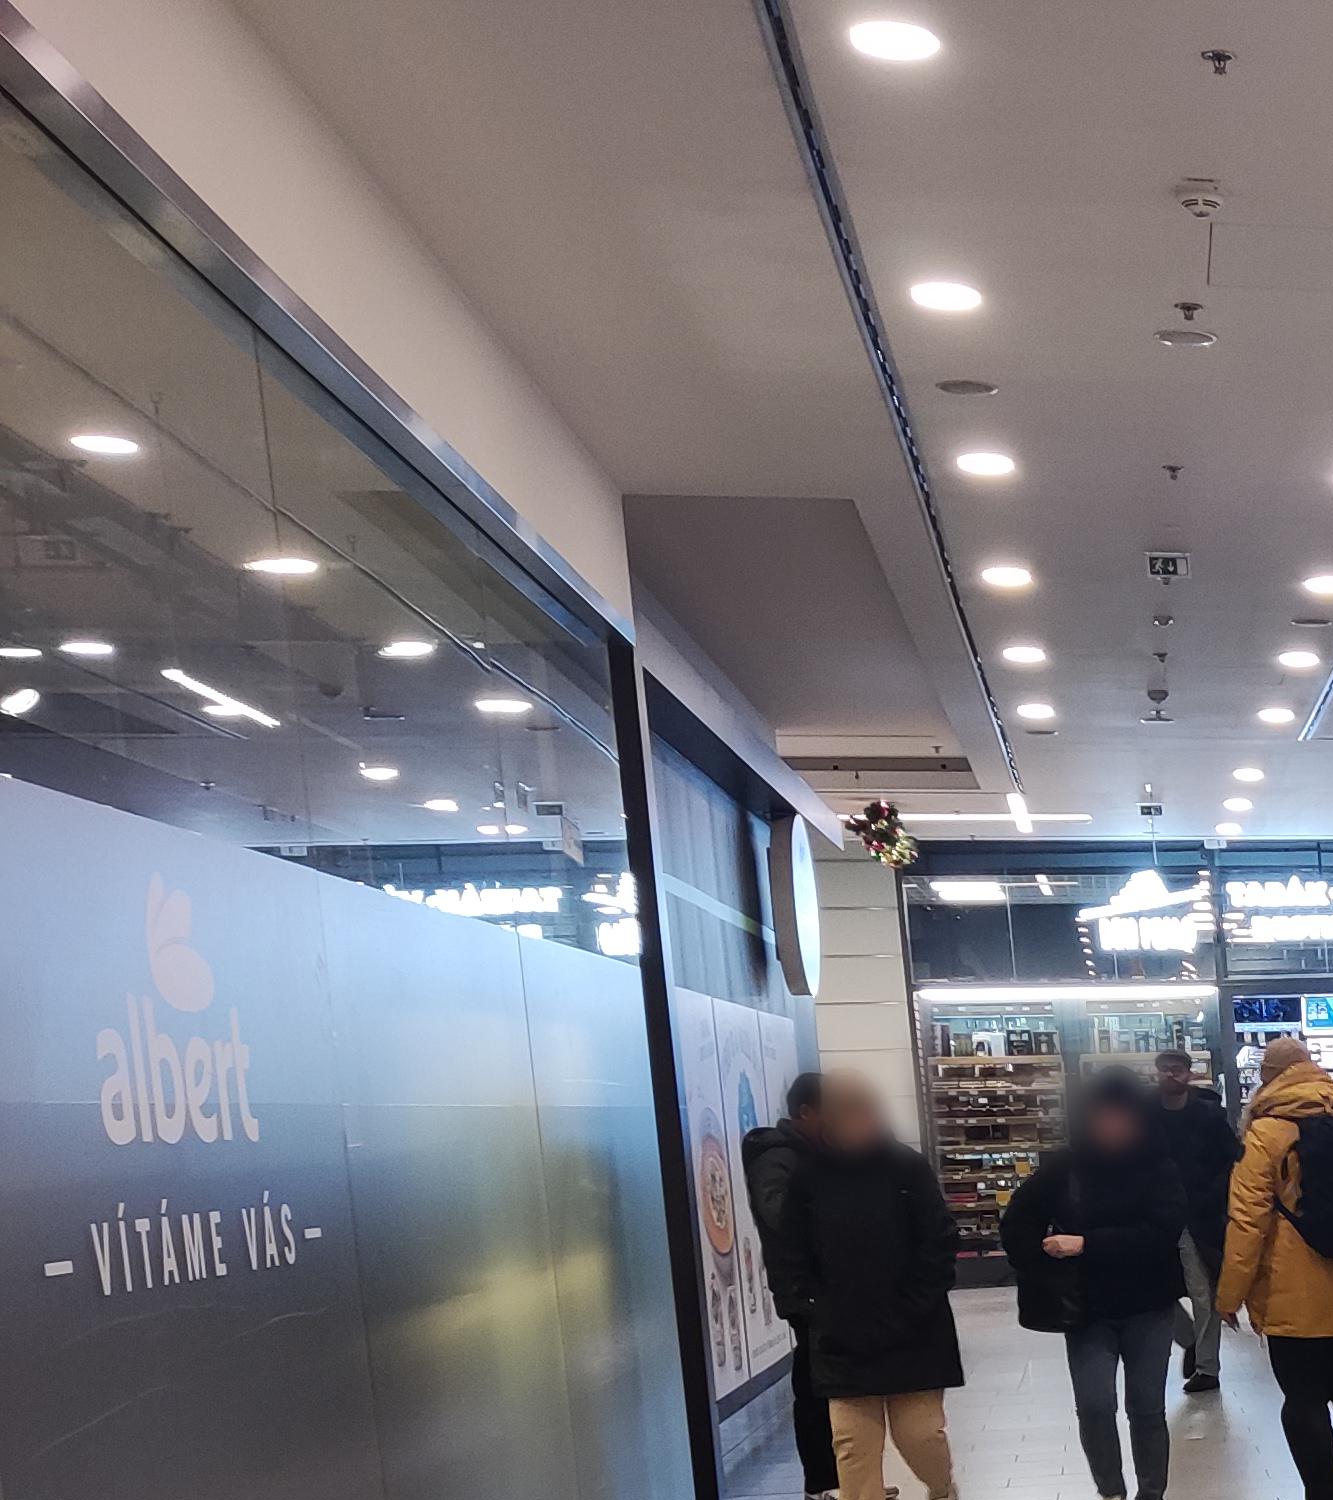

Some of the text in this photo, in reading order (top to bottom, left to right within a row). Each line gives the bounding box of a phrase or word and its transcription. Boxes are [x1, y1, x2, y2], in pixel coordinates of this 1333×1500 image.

[96, 991, 260, 1146] albert
[90, 1190, 296, 1296] VÍTÁME VÁS
